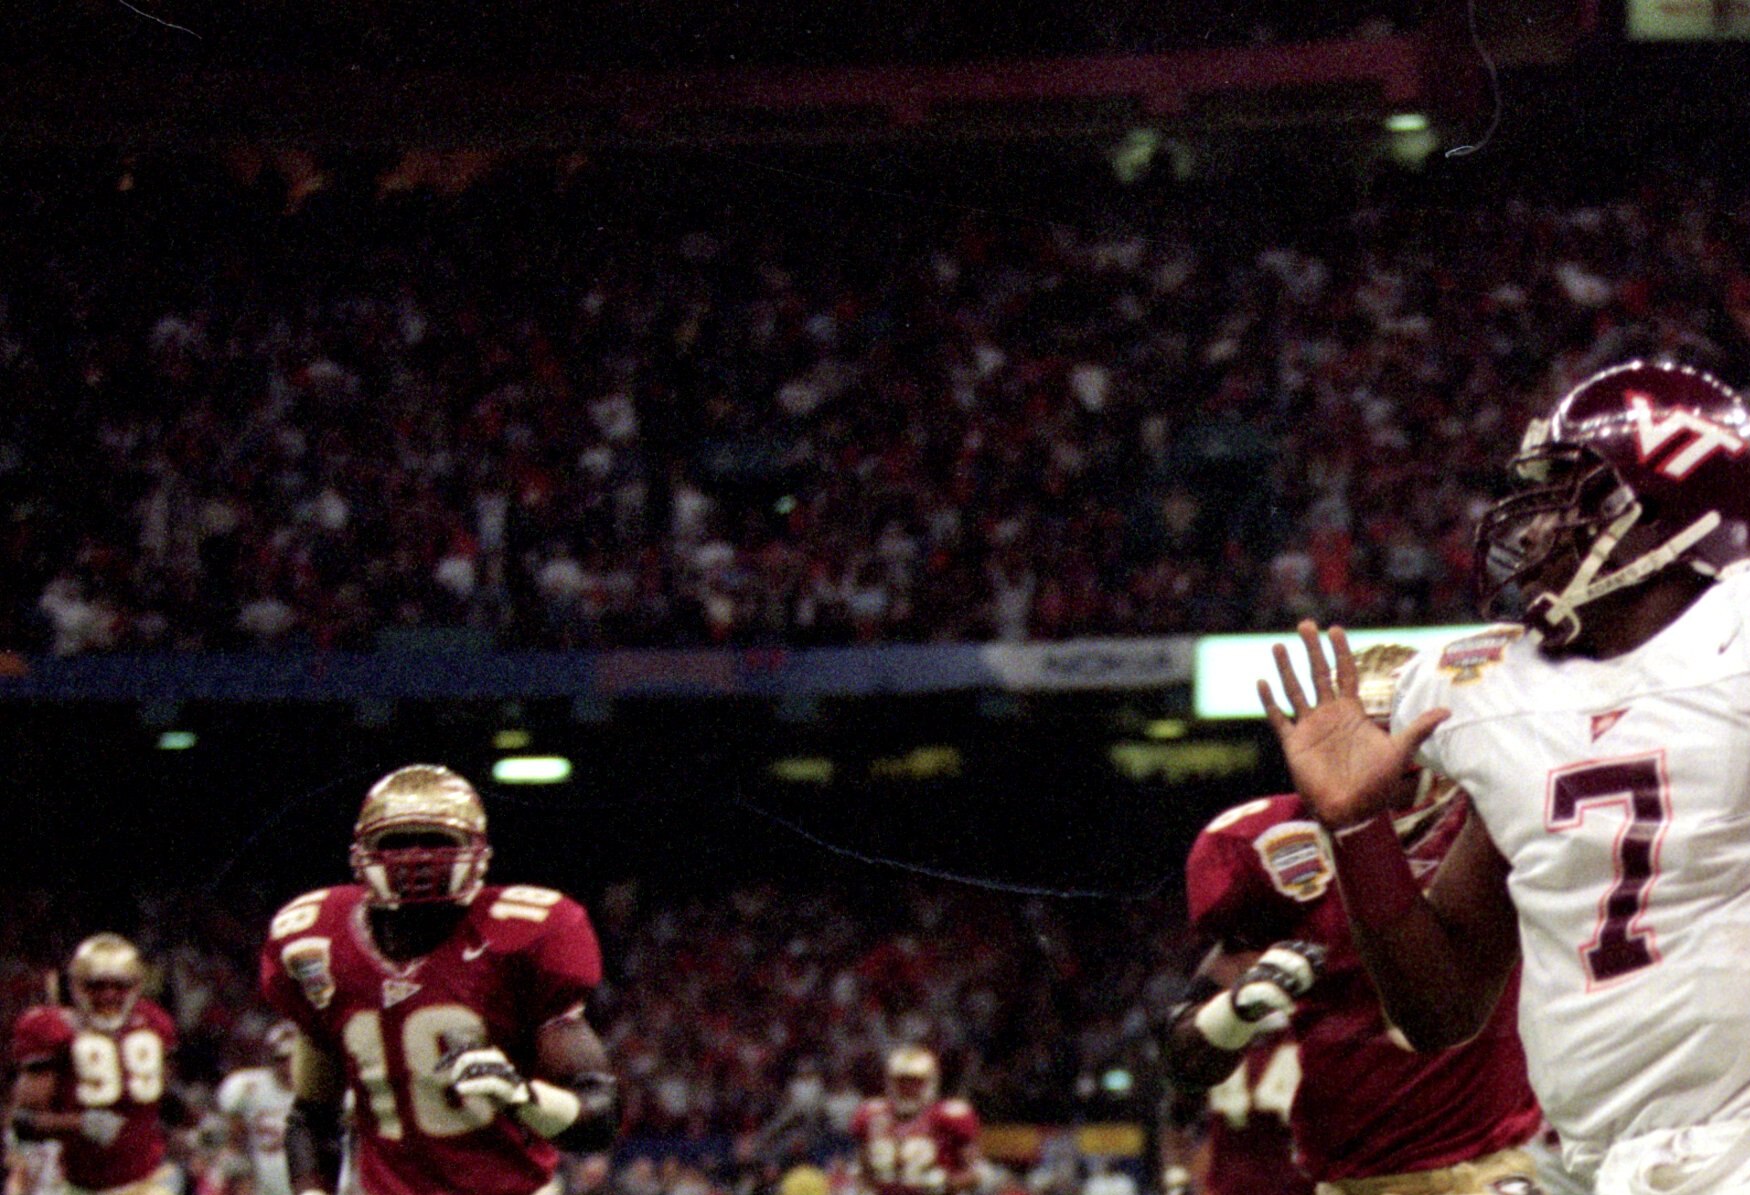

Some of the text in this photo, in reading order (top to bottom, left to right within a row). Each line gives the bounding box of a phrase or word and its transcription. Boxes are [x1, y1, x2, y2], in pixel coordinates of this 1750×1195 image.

[1624, 388, 1750, 481] VT
[1543, 747, 1673, 993] 7
[73, 1030, 165, 1106] 99
